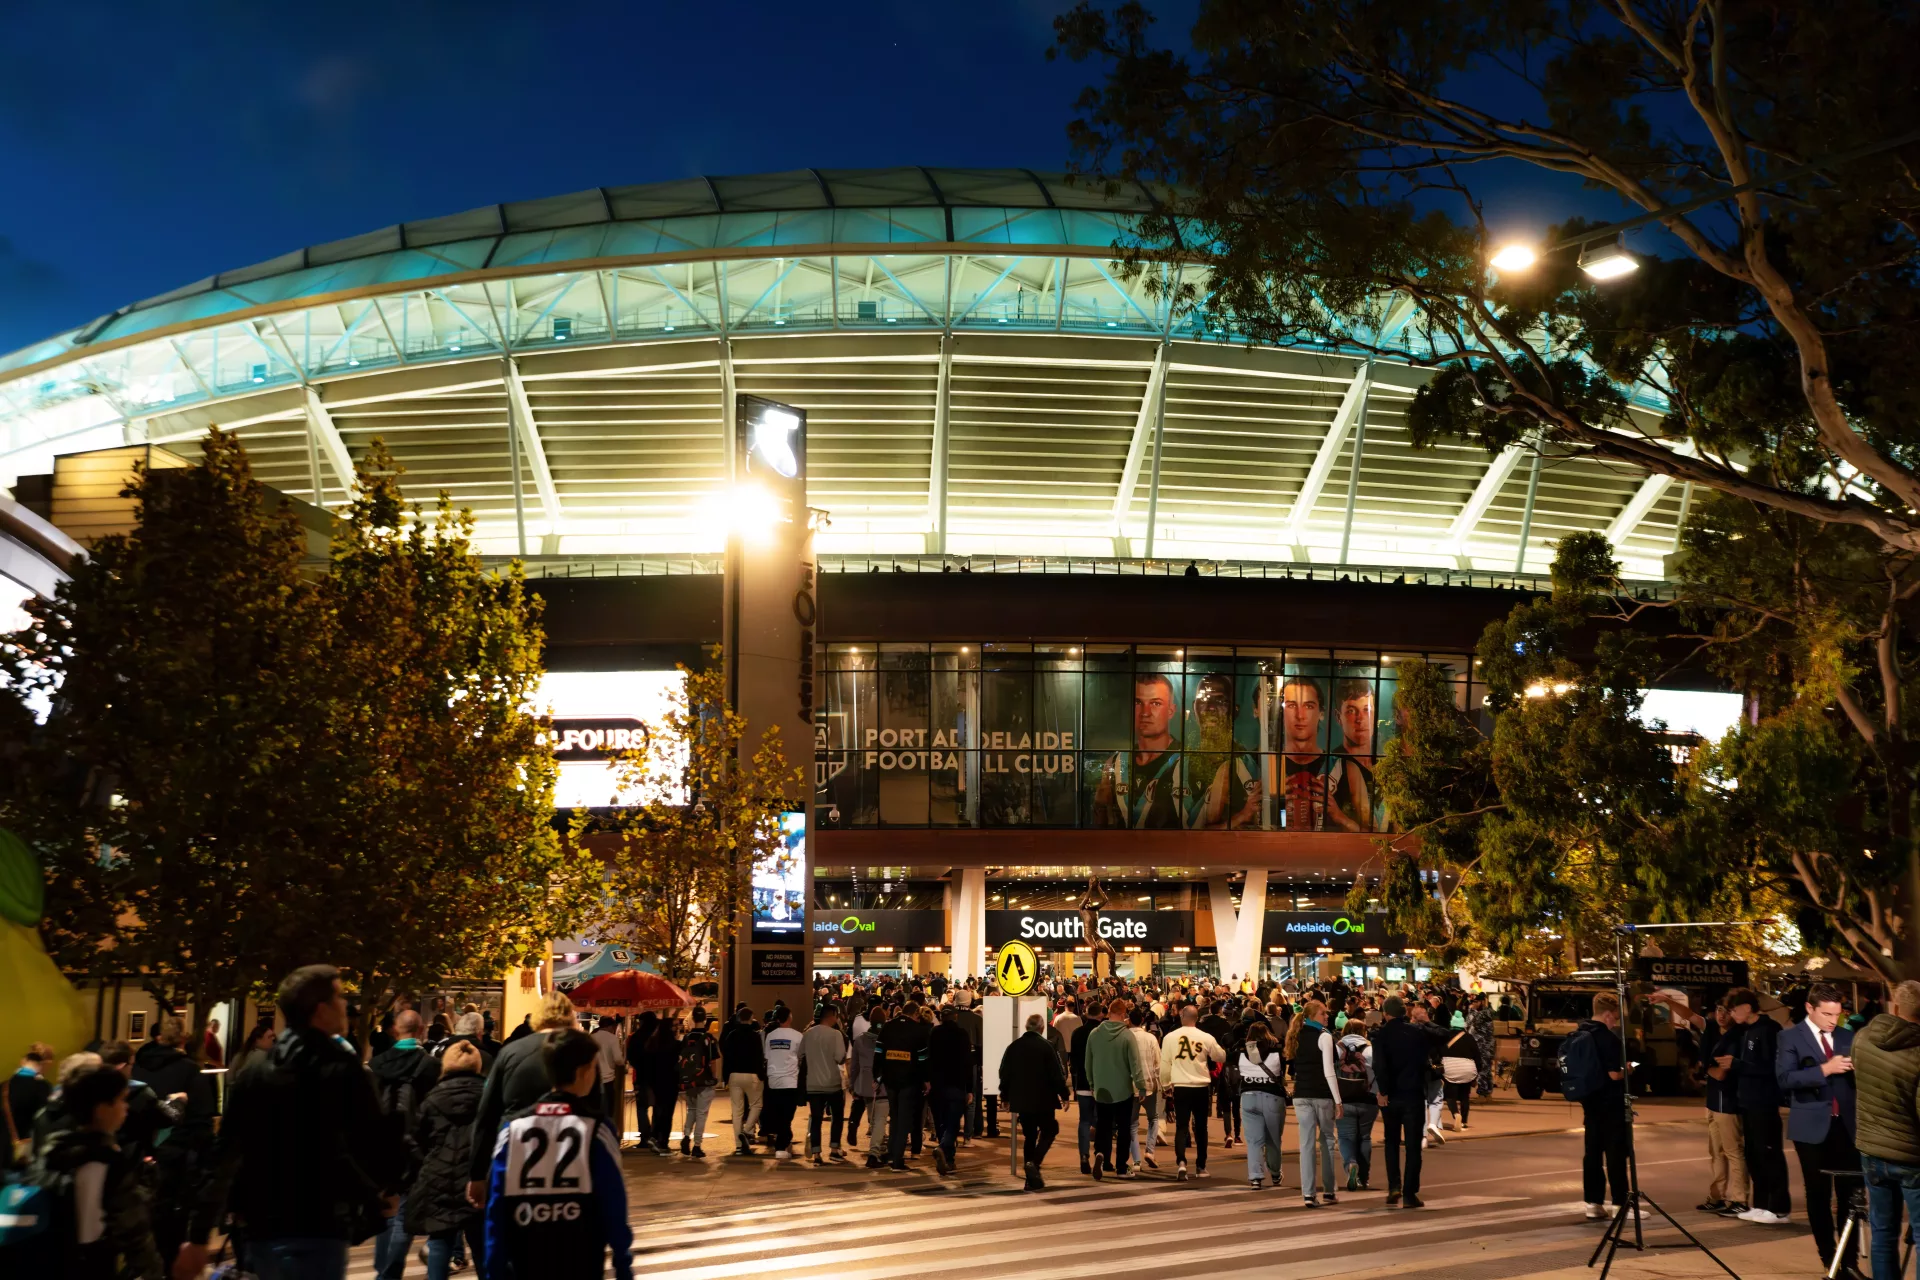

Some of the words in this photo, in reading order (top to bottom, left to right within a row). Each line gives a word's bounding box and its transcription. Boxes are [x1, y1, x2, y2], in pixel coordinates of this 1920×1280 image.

[865, 729, 928, 748] PORT
[1014, 754, 1075, 774] CLUB
[812, 921, 839, 932] laide
[840, 916, 875, 934] Oval
[1020, 916, 1085, 938] South
[1097, 917, 1148, 938] Gate
[1285, 922, 1331, 933] Adelaide
[1332, 917, 1365, 935] Oval
[1651, 962, 1734, 976] OFFICIAL
[1650, 973, 1734, 984] MERCHANDISE
[537, 1103, 570, 1114] KFC
[519, 1127, 583, 1189] 22
